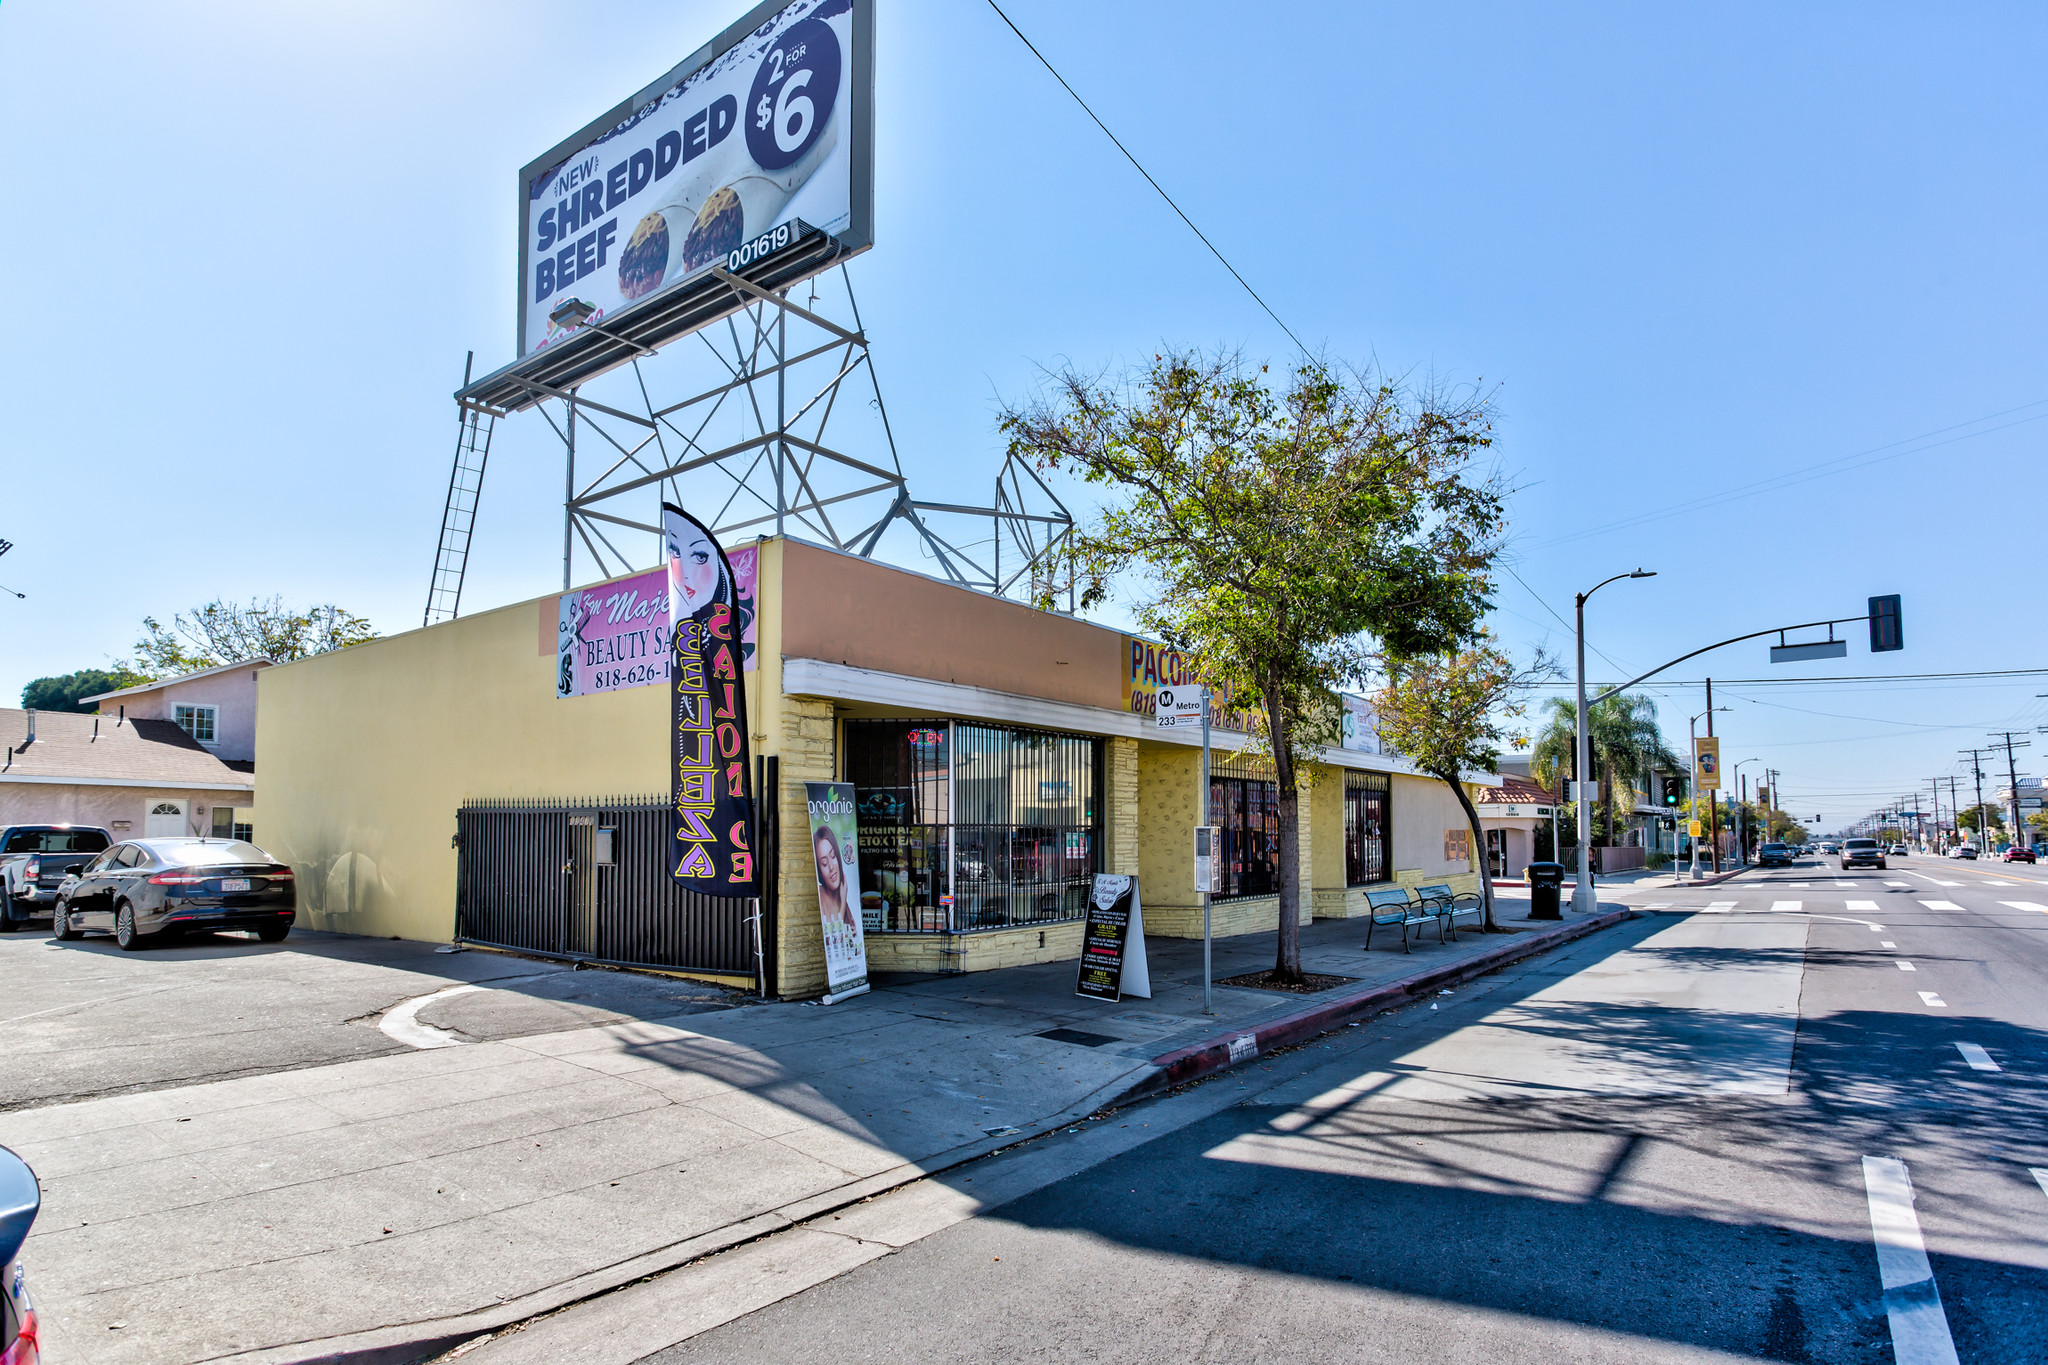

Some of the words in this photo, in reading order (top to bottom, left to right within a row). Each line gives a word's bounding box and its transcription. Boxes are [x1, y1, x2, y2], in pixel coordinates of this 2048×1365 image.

[767, 48, 785, 86] 2
[785, 44, 807, 67] FOR
[756, 68, 815, 153] $6
[536, 93, 738, 252] SHREDDED
[558, 155, 595, 193] NEW
[535, 217, 618, 304] BEEF
[728, 225, 789, 272] 001619
[586, 629, 650, 667] BEAUTY
[595, 660, 670, 689] 818-626-1
[1158, 716, 1176, 727] 233
[1176, 702, 1200, 710] Metro
[907, 731, 943, 745] OEN
[808, 796, 853, 823] organic
[857, 826, 913, 835] RIGINAL
[858, 836, 889, 847] ETOX
